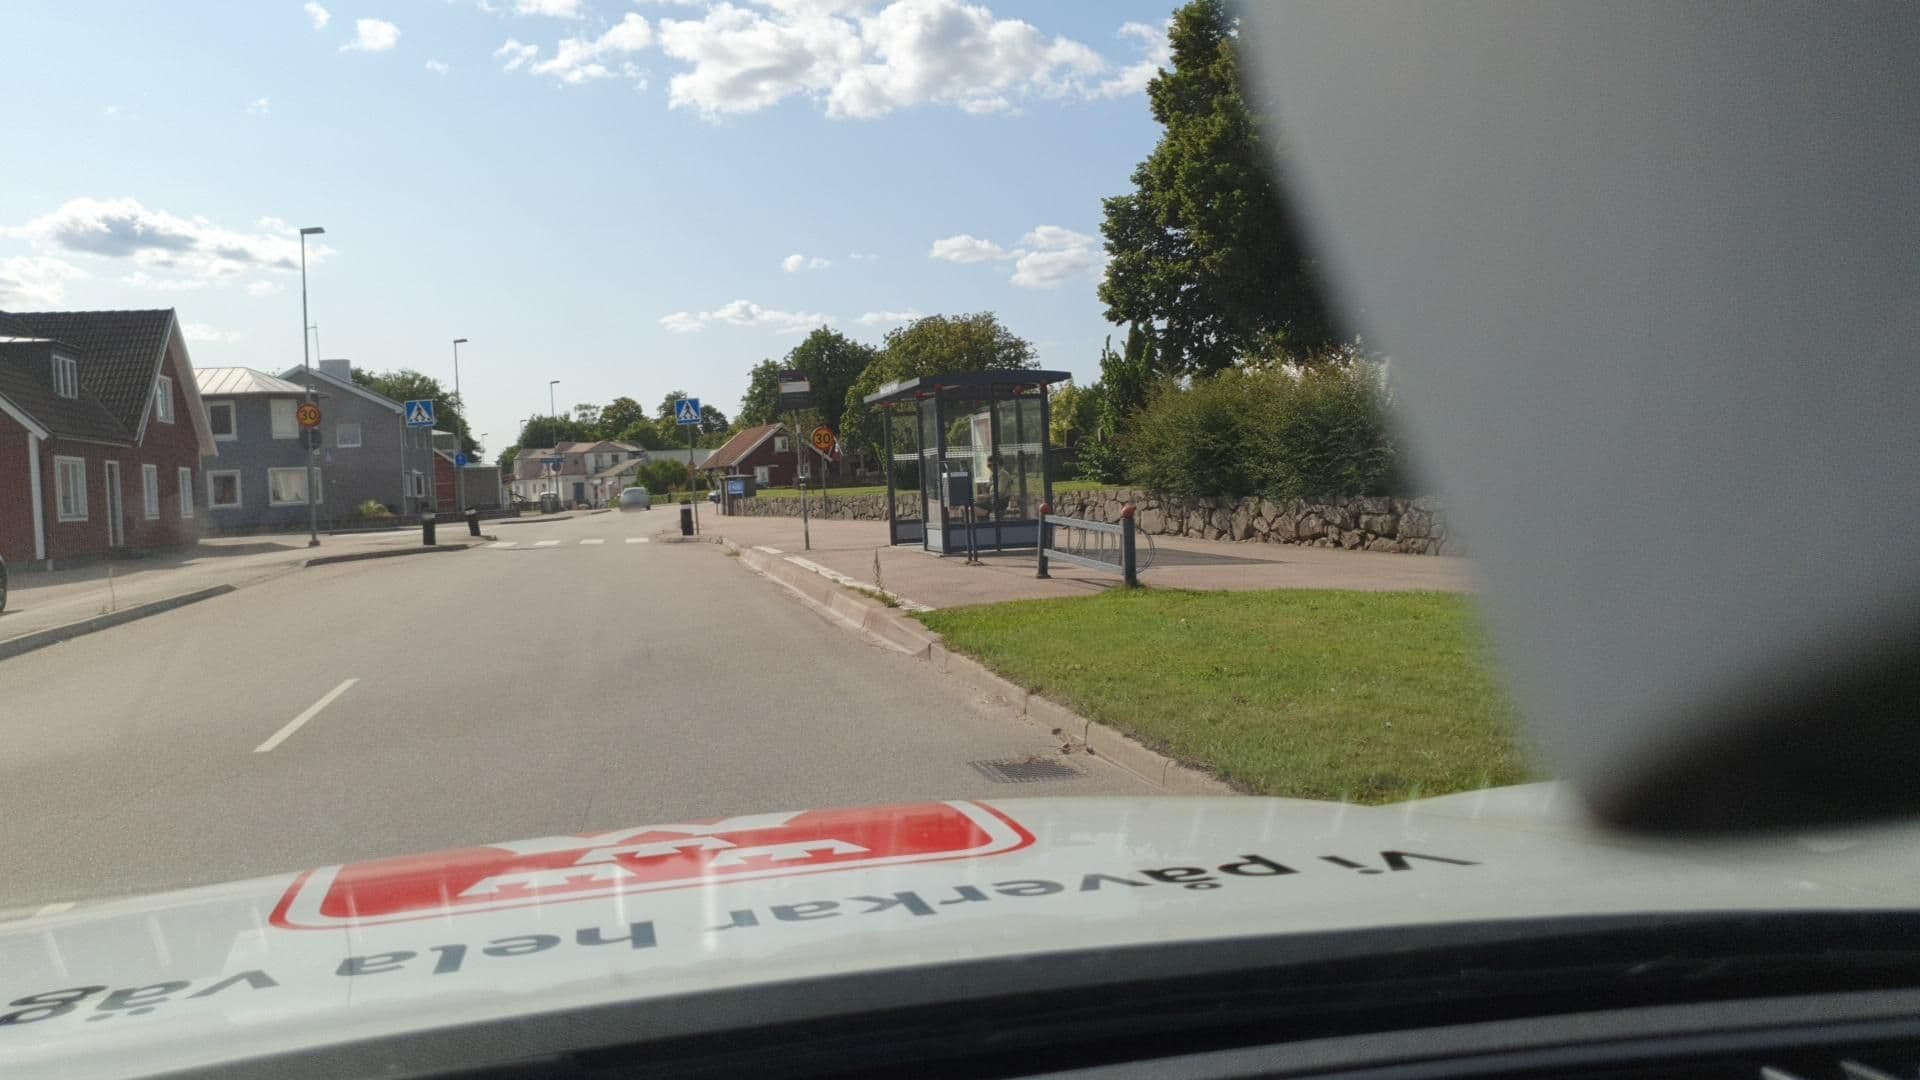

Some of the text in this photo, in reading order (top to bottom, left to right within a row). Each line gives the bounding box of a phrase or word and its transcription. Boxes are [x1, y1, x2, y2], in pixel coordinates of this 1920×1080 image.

[300, 409, 316, 421] 30
[815, 433, 831, 445] 30
[1319, 849, 1484, 874] Vi
[704, 853, 1302, 931] påverkar
[335, 920, 657, 977] hela
